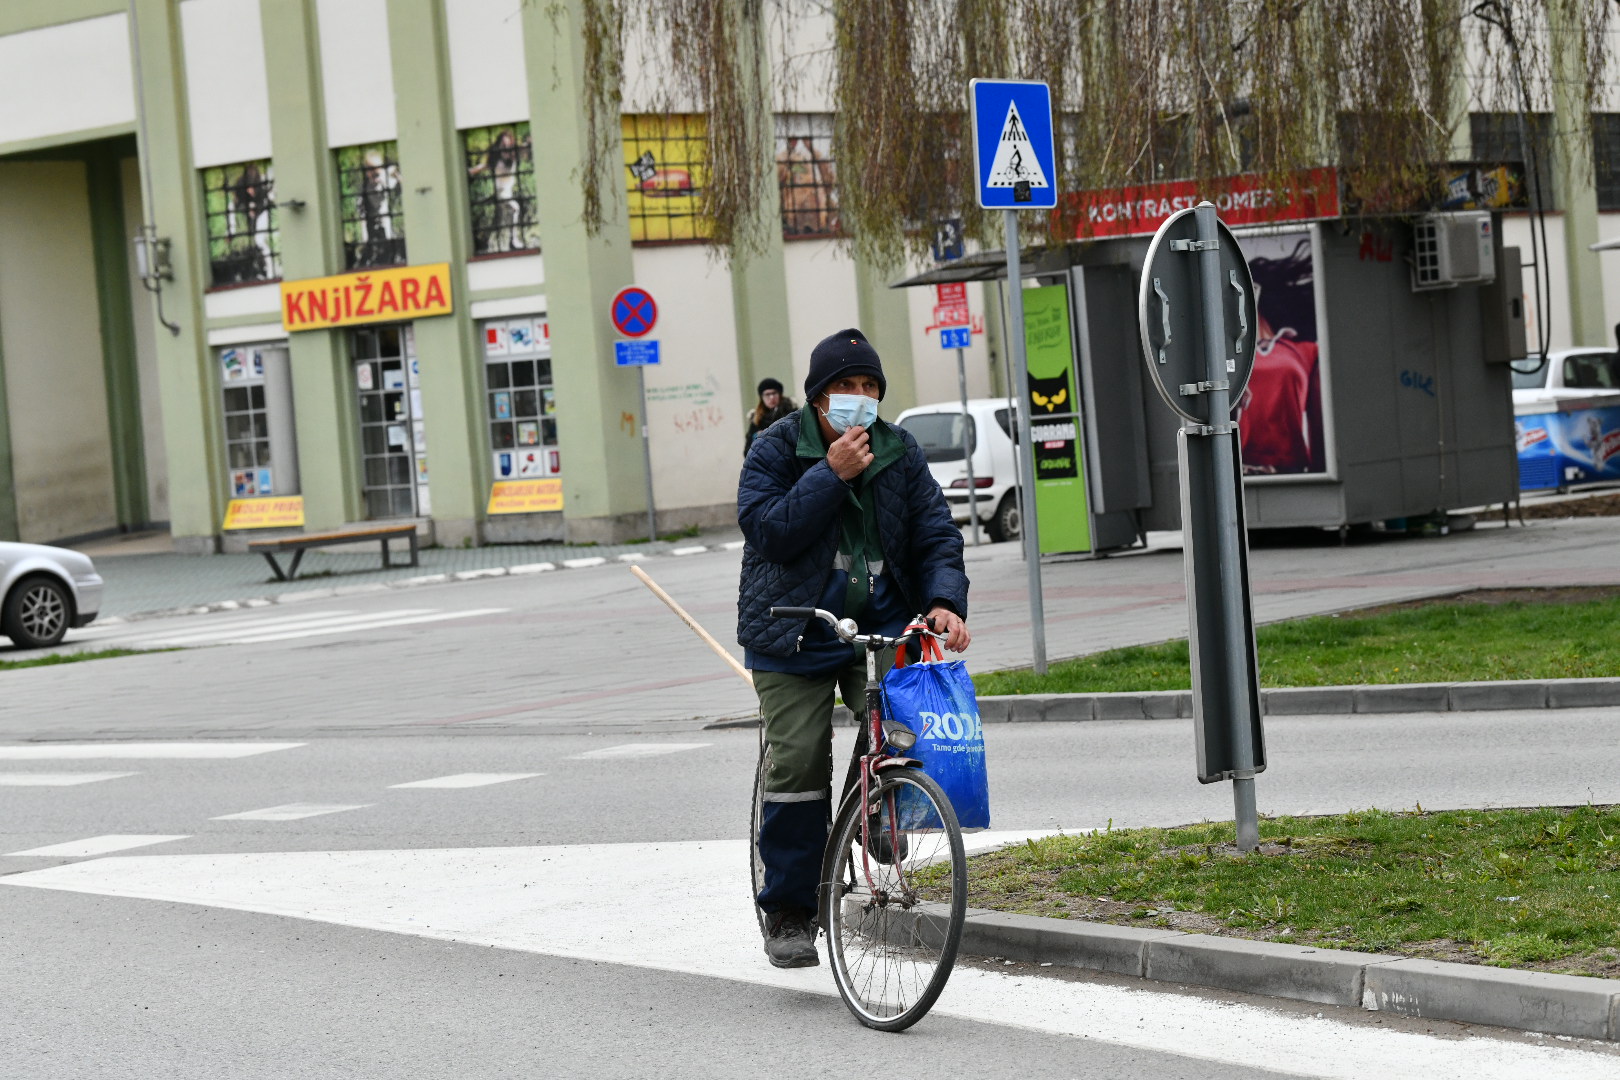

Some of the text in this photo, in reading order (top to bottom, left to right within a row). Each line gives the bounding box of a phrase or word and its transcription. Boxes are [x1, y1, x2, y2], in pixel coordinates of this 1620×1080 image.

[1087, 196, 1194, 223] KONTRAST
[932, 743, 951, 752] Tamo
[953, 743, 966, 754] gde
